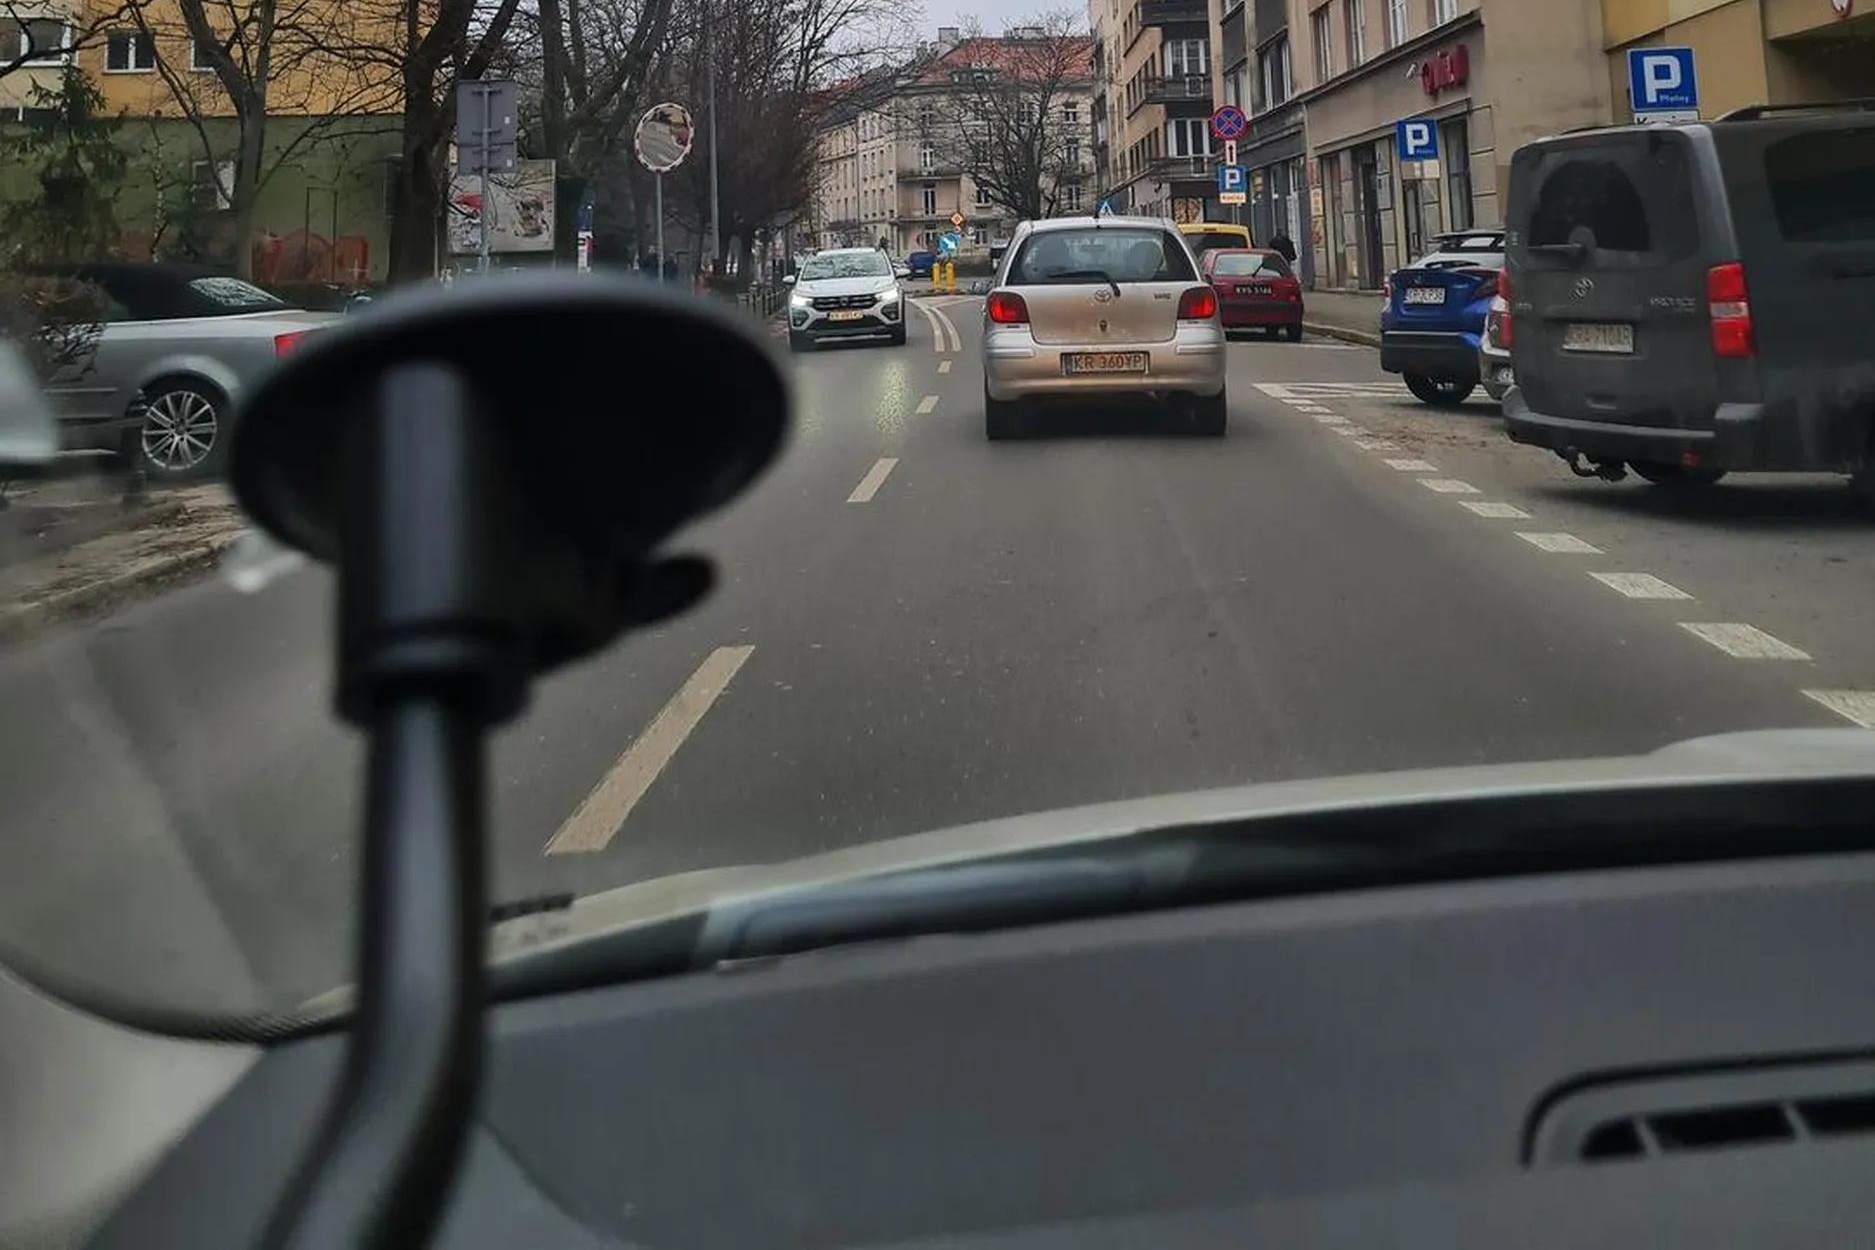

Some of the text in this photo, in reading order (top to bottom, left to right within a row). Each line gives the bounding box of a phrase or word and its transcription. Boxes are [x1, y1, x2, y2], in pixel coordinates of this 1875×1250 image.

[1643, 55, 1682, 103] P
[1405, 123, 1430, 155] P
[1225, 169, 1241, 190] P
[1073, 355, 1094, 370] KR
